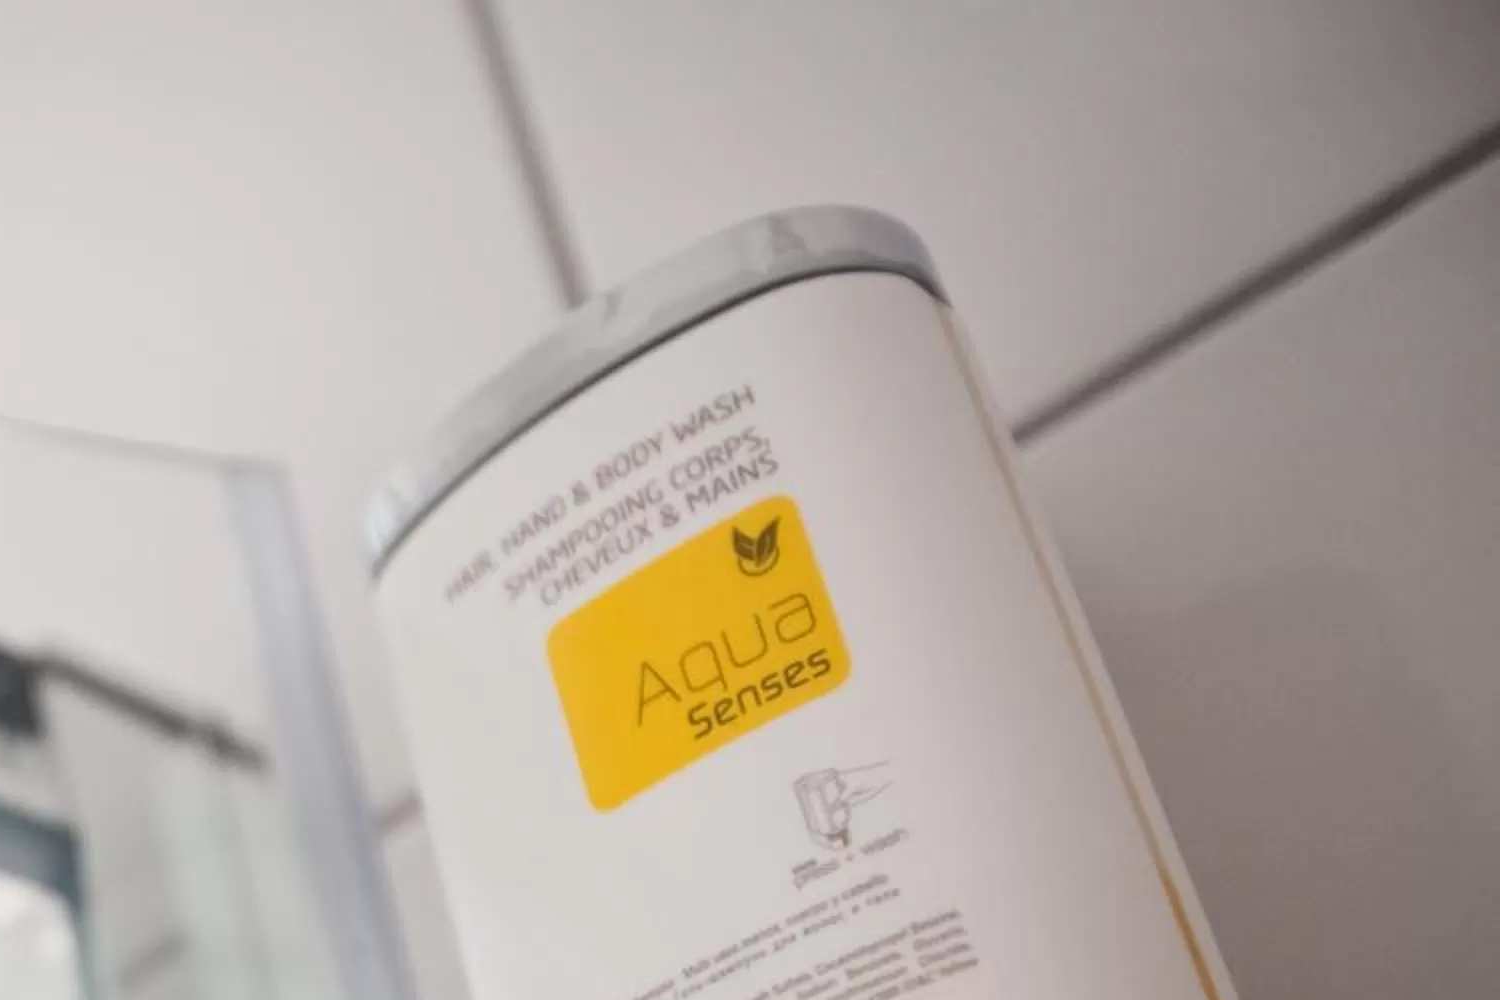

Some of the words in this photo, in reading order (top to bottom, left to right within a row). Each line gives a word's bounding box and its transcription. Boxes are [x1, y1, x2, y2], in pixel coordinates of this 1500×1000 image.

[500, 495, 566, 556] HAND
[571, 481, 591, 506] &
[595, 432, 662, 490] BODY
[670, 384, 756, 443] WASH
[502, 478, 664, 602] SHAMPOOING
[668, 427, 772, 490] CORPS,
[540, 517, 654, 606] CHEVEUX
[658, 503, 682, 528] &
[685, 451, 779, 513] MAINS
[637, 592, 817, 728] Aqua
[687, 648, 832, 741] Senses
